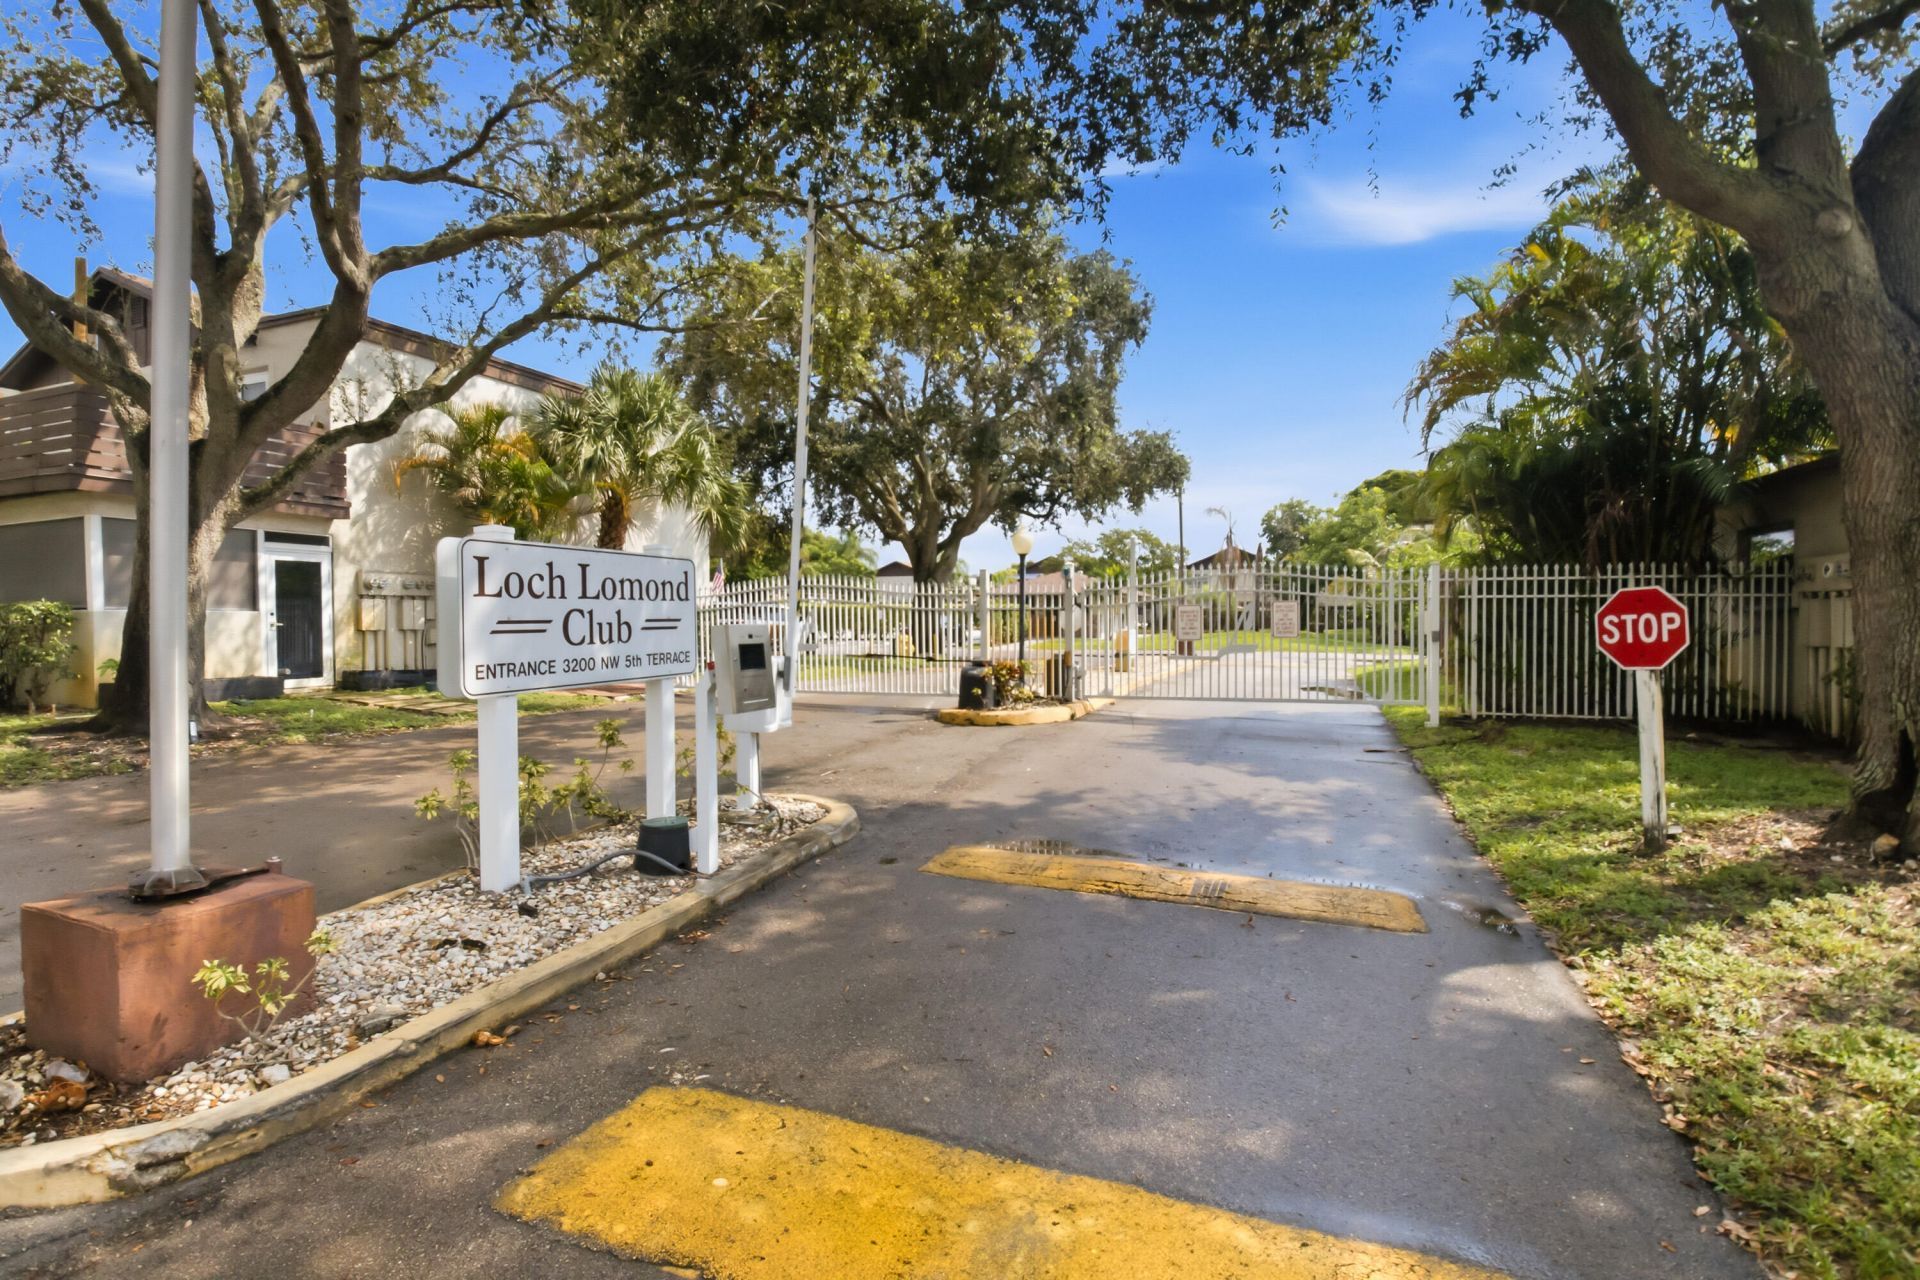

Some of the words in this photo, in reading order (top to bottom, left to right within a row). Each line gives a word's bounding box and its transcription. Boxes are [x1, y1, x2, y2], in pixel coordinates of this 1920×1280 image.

[473, 555, 567, 600] Loch
[577, 563, 690, 602] Lomond
[562, 608, 632, 646] Club
[1602, 612, 1681, 644] STOP
[476, 660, 557, 681] ENTRANCE
[562, 657, 596, 673] 3200
[601, 655, 620, 670] NW
[625, 653, 642, 667] 5th
[646, 651, 691, 666] TERRACE
